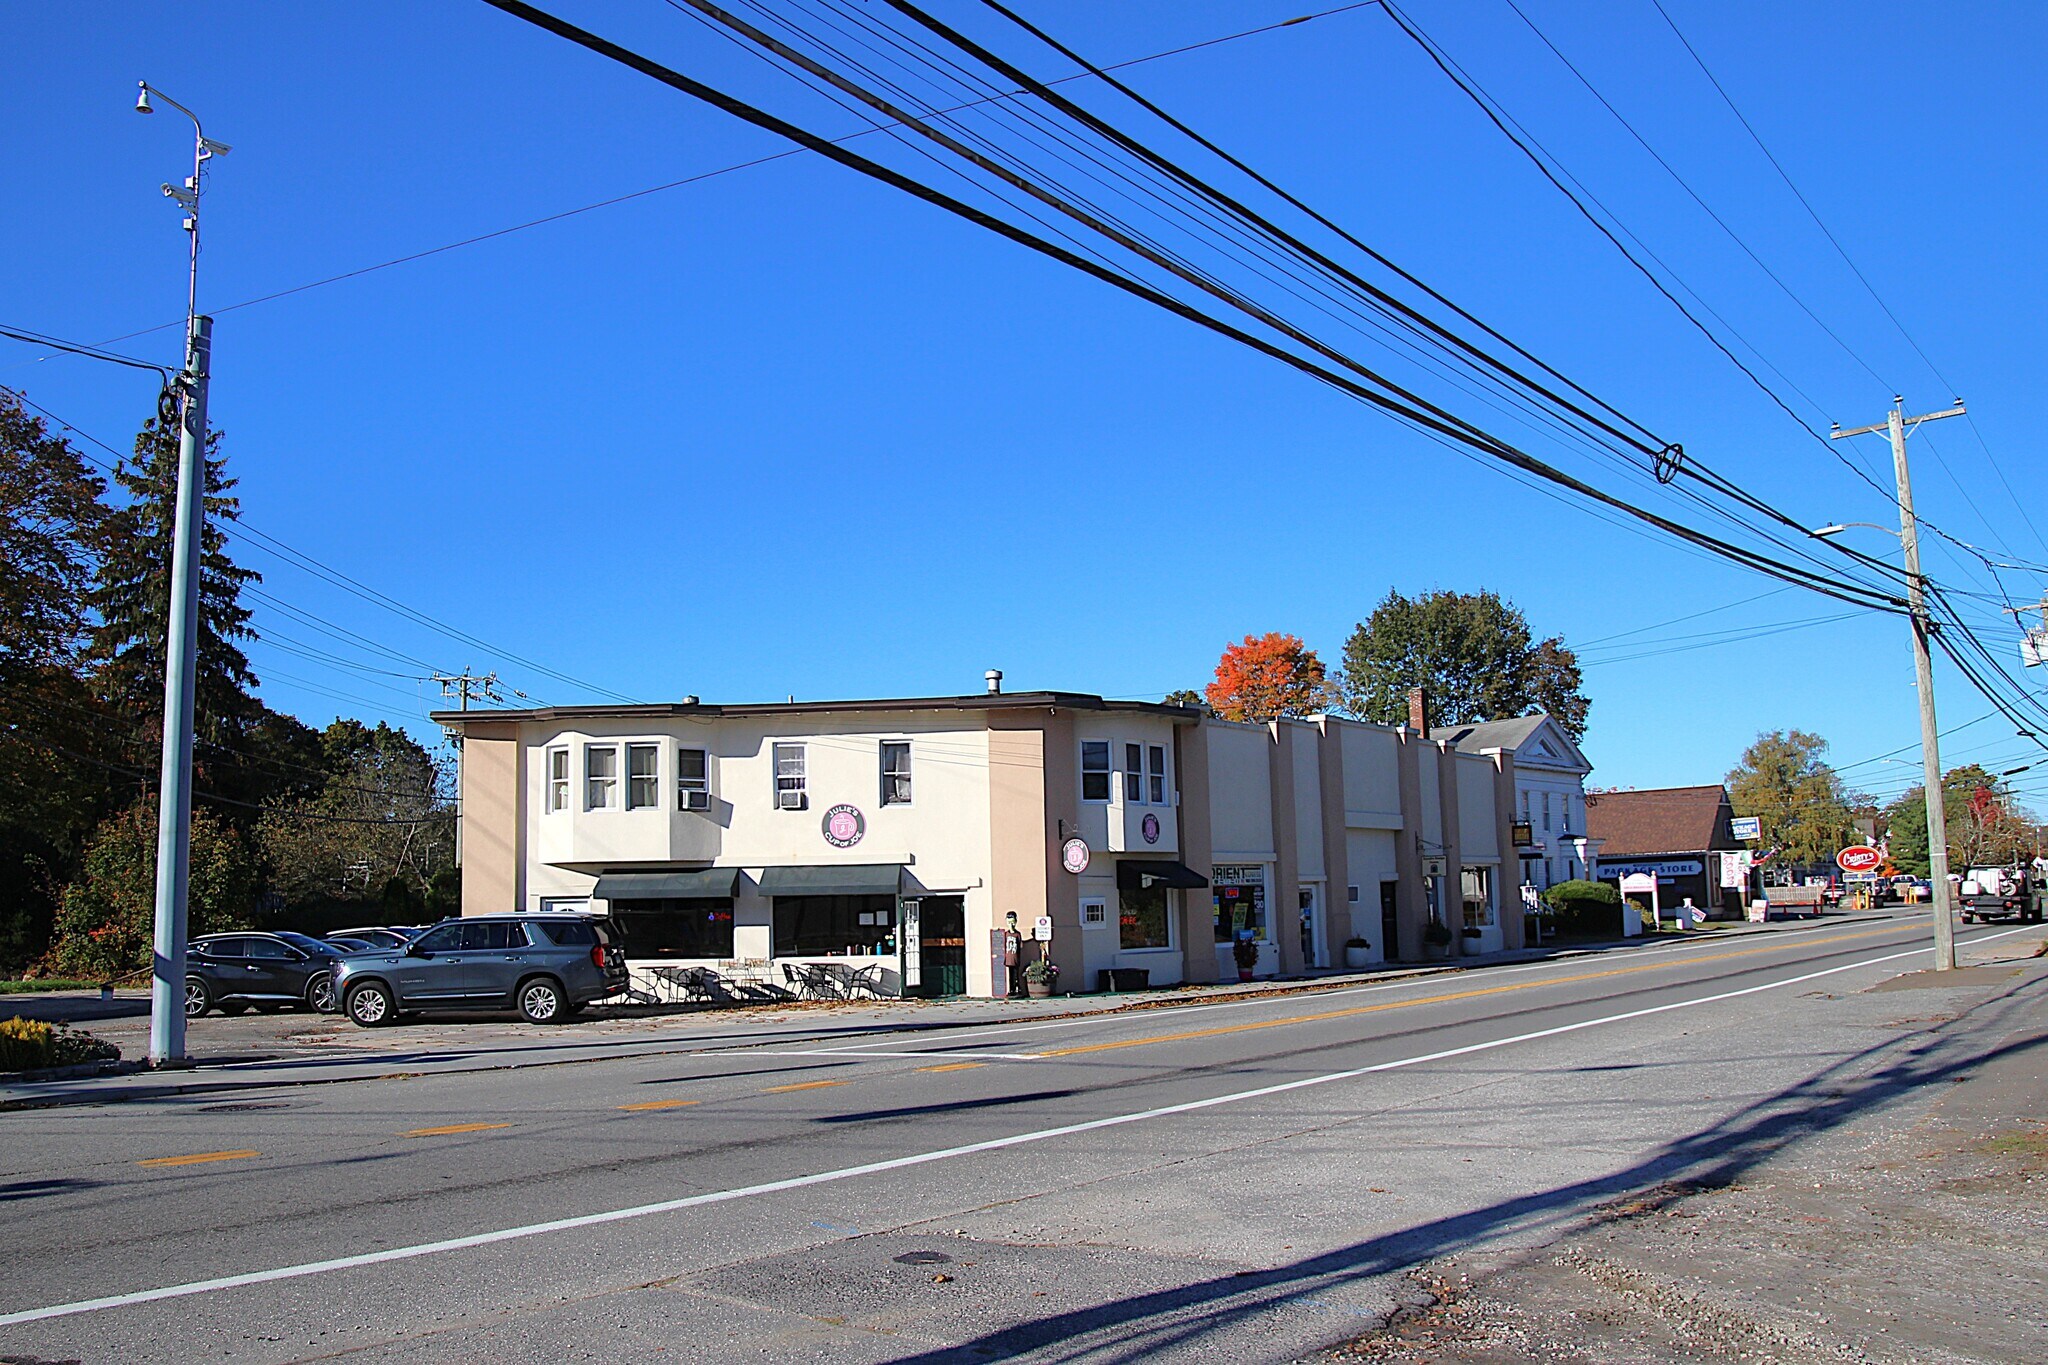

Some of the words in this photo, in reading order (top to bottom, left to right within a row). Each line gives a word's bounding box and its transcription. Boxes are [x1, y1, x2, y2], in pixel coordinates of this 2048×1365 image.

[829, 806, 859, 818] JULIE'S
[825, 832, 841, 846] CUP
[850, 831, 862, 845] JOE
[1660, 865, 1694, 873] STORE
